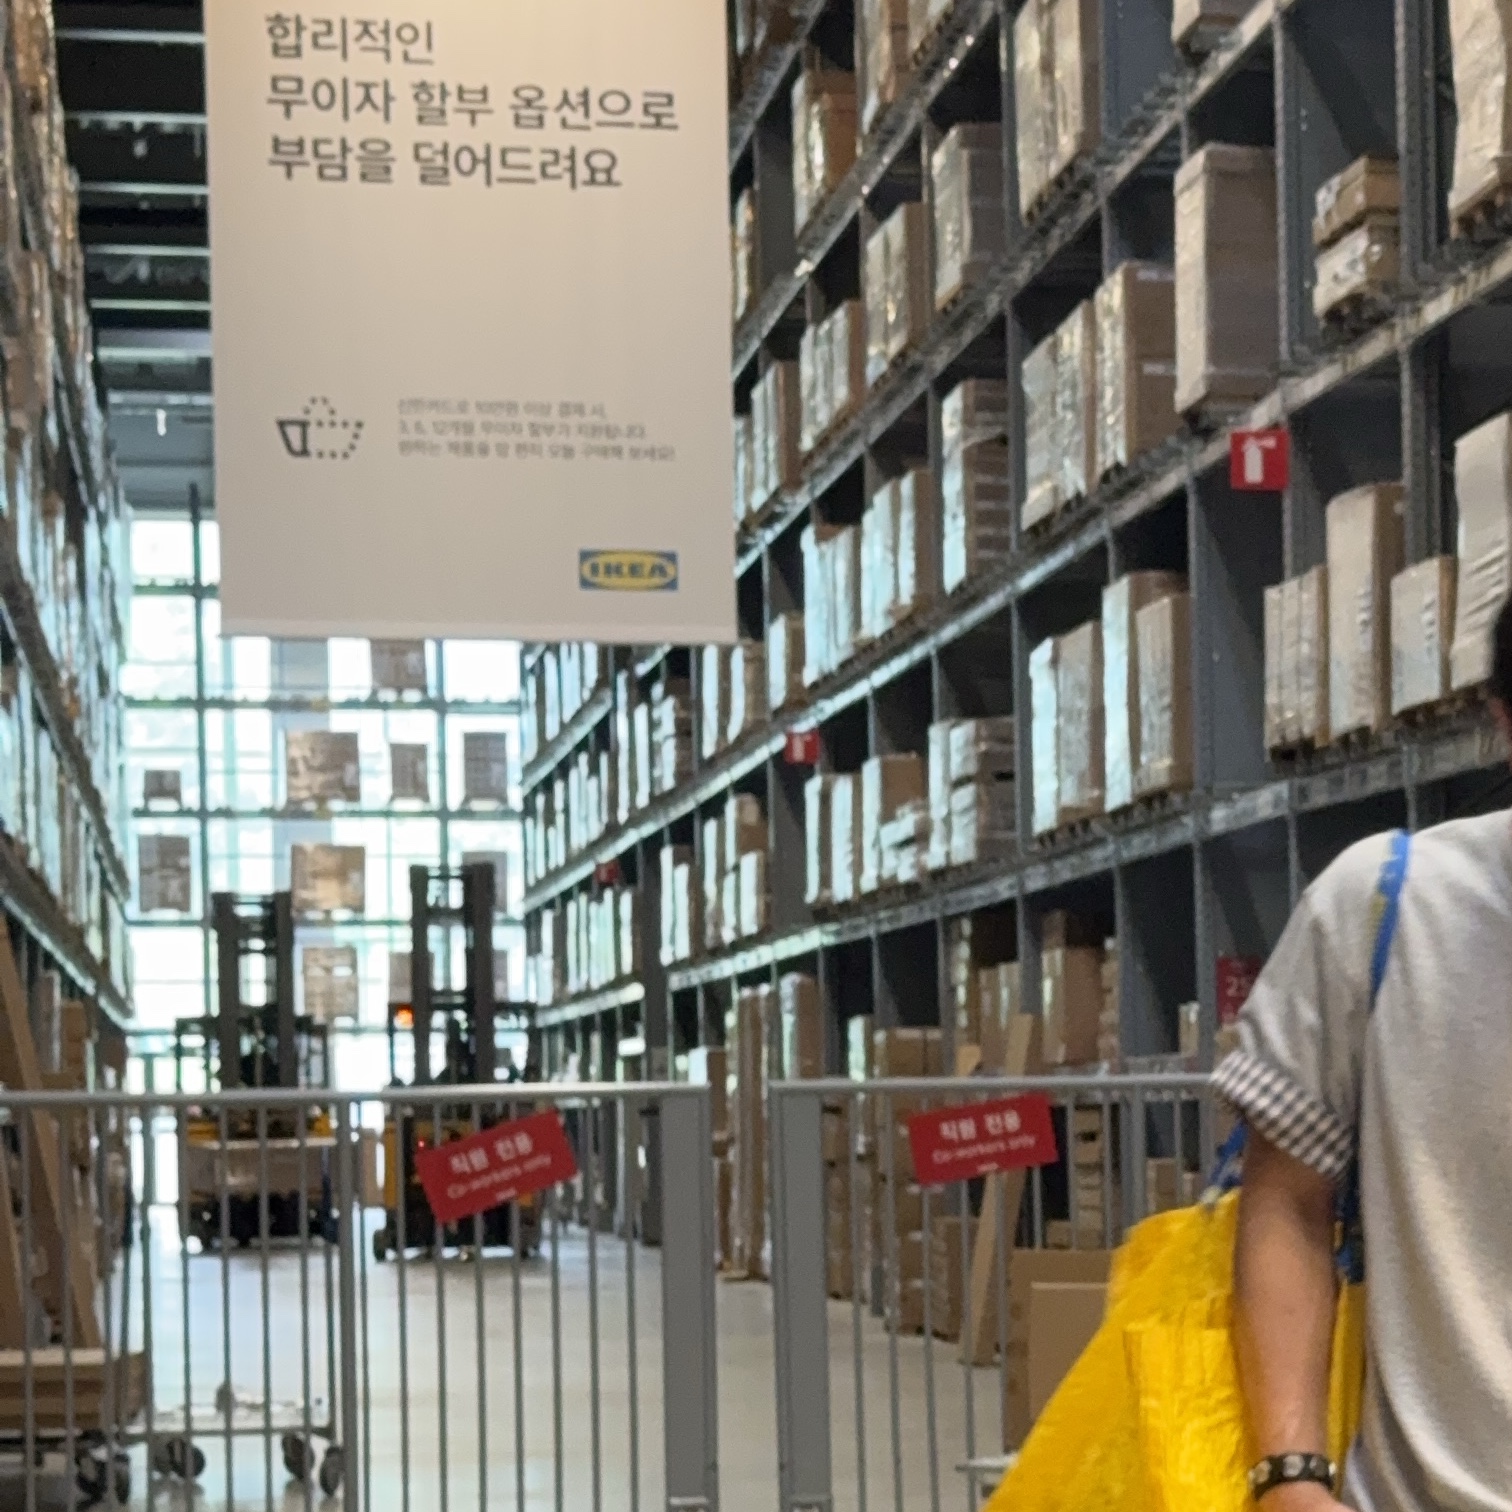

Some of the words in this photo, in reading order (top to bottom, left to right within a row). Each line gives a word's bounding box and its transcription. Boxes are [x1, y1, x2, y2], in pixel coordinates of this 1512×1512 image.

[266, 13, 435, 66] 합리적인
[267, 74, 396, 123] 무이자
[411, 80, 494, 127] 할부
[509, 84, 680, 132] 옵션으로
[268, 135, 396, 184] 부담을
[413, 140, 622, 190] 덜어드려요
[590, 562, 668, 579] IKEA
